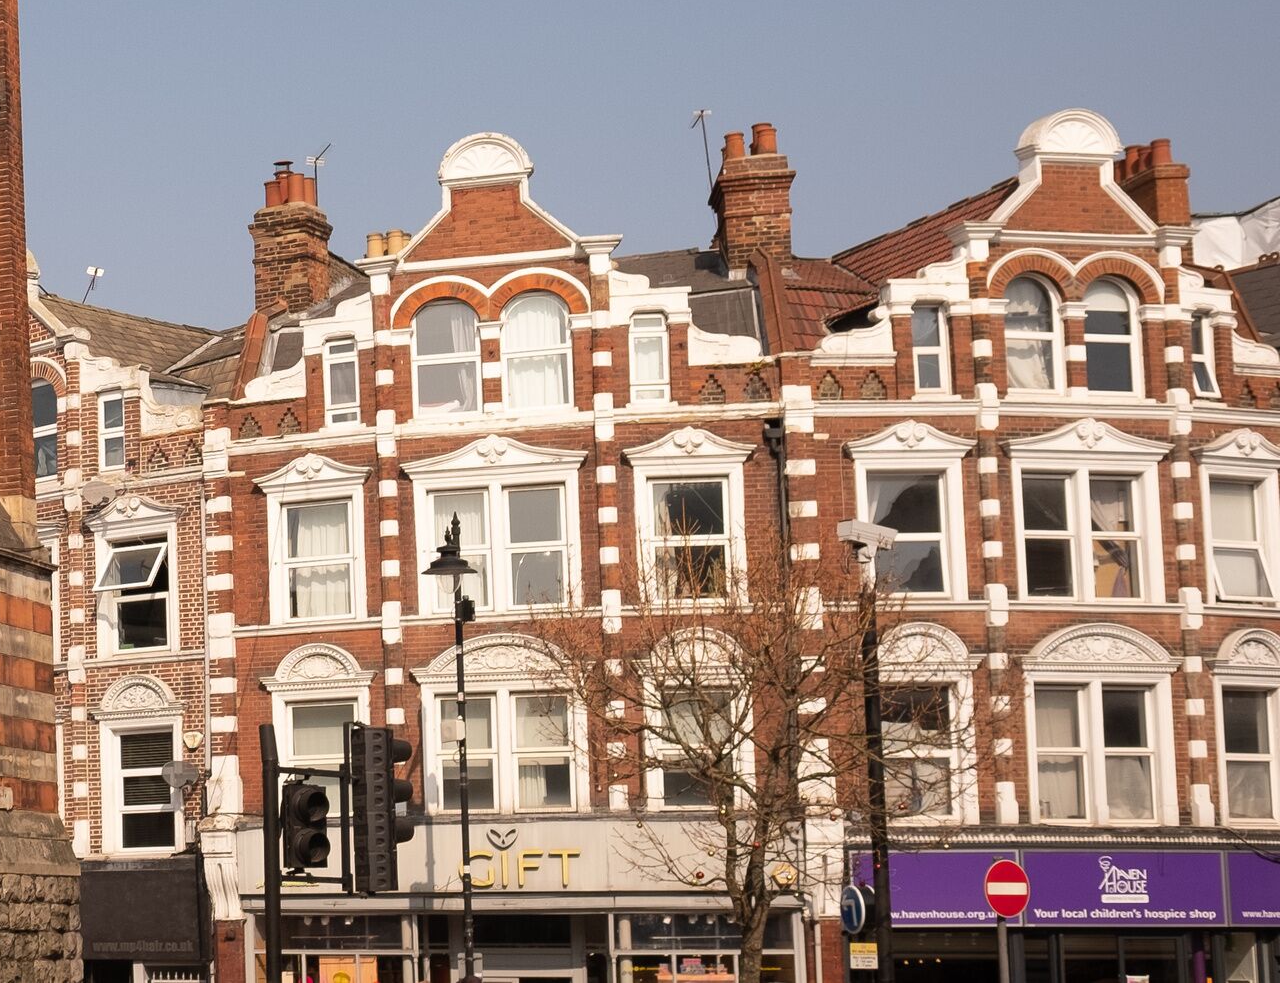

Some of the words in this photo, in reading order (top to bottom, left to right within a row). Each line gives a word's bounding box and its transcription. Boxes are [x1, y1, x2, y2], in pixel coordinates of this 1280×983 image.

[459, 849, 581, 888] GIFT
[1034, 909, 1059, 918] Your
[1062, 909, 1087, 918] local
[1090, 909, 1142, 919] children's
[1145, 909, 1186, 921] hospice
[1189, 909, 1216, 921] shop
